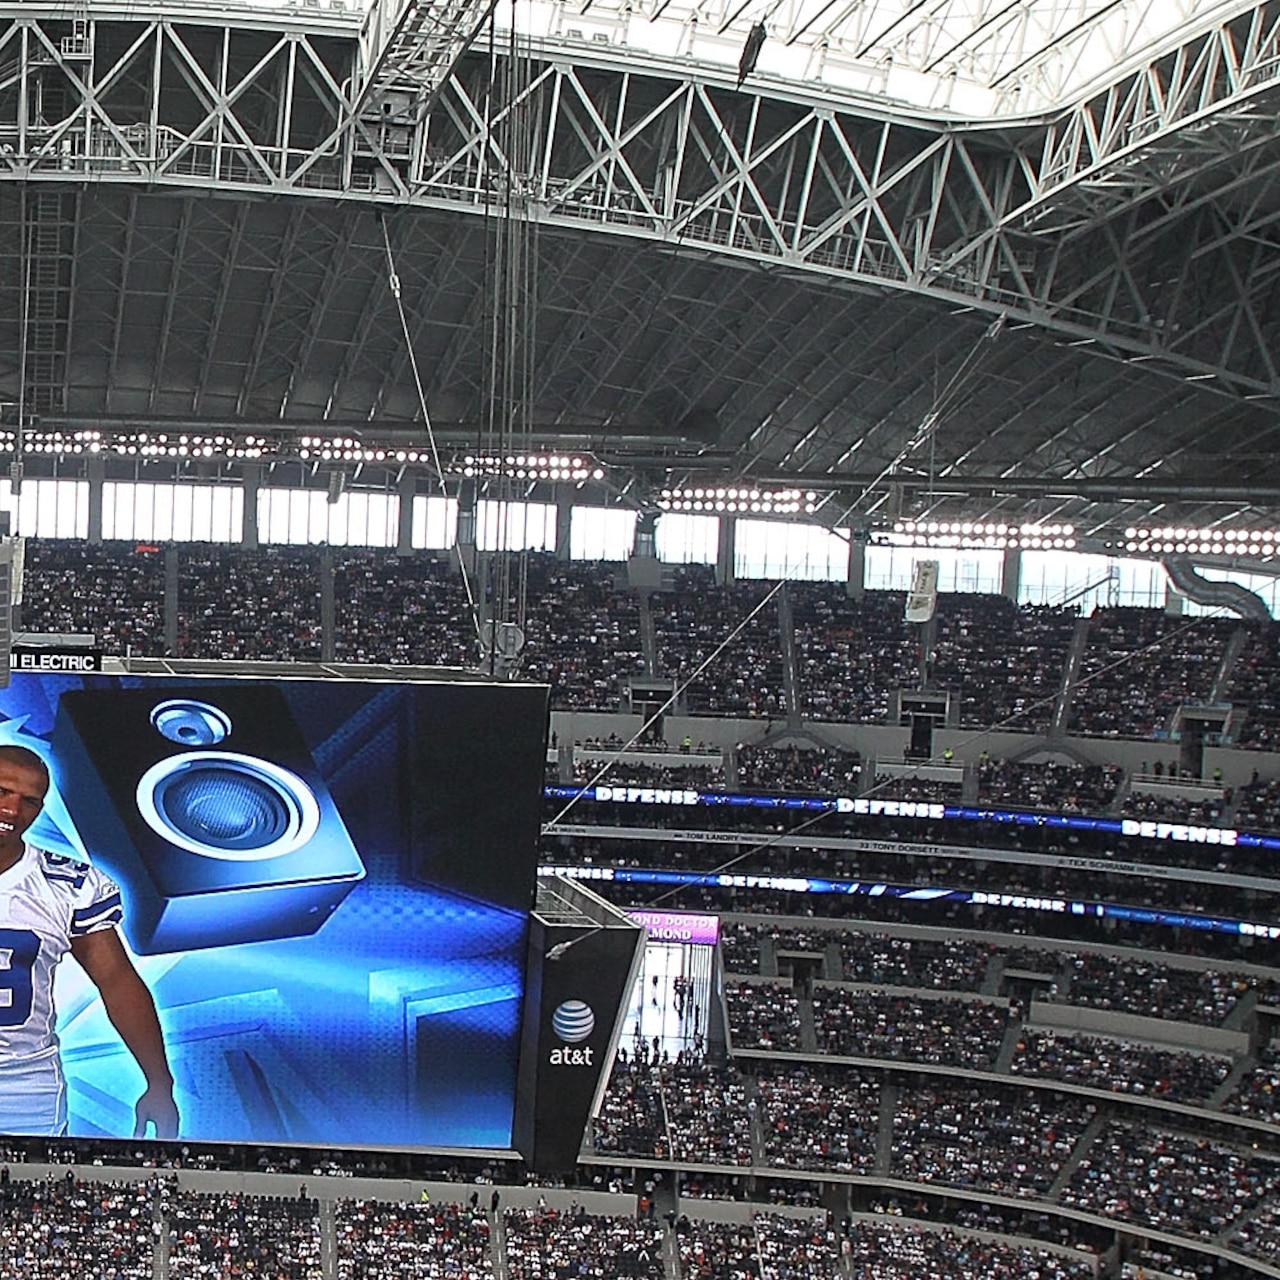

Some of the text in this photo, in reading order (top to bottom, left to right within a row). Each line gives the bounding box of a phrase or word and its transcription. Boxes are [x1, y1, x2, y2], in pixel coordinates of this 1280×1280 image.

[24, 655, 95, 670] ELECTRIC
[595, 786, 698, 805] DEFENSE
[837, 798, 945, 819] DEFENSE
[706, 833, 739, 842] LANDRY
[1121, 820, 1237, 846] DEFENSE
[972, 891, 1066, 912] DEFENSE
[664, 915, 718, 929] DOCTOR
[549, 1045, 594, 1067] at&t
